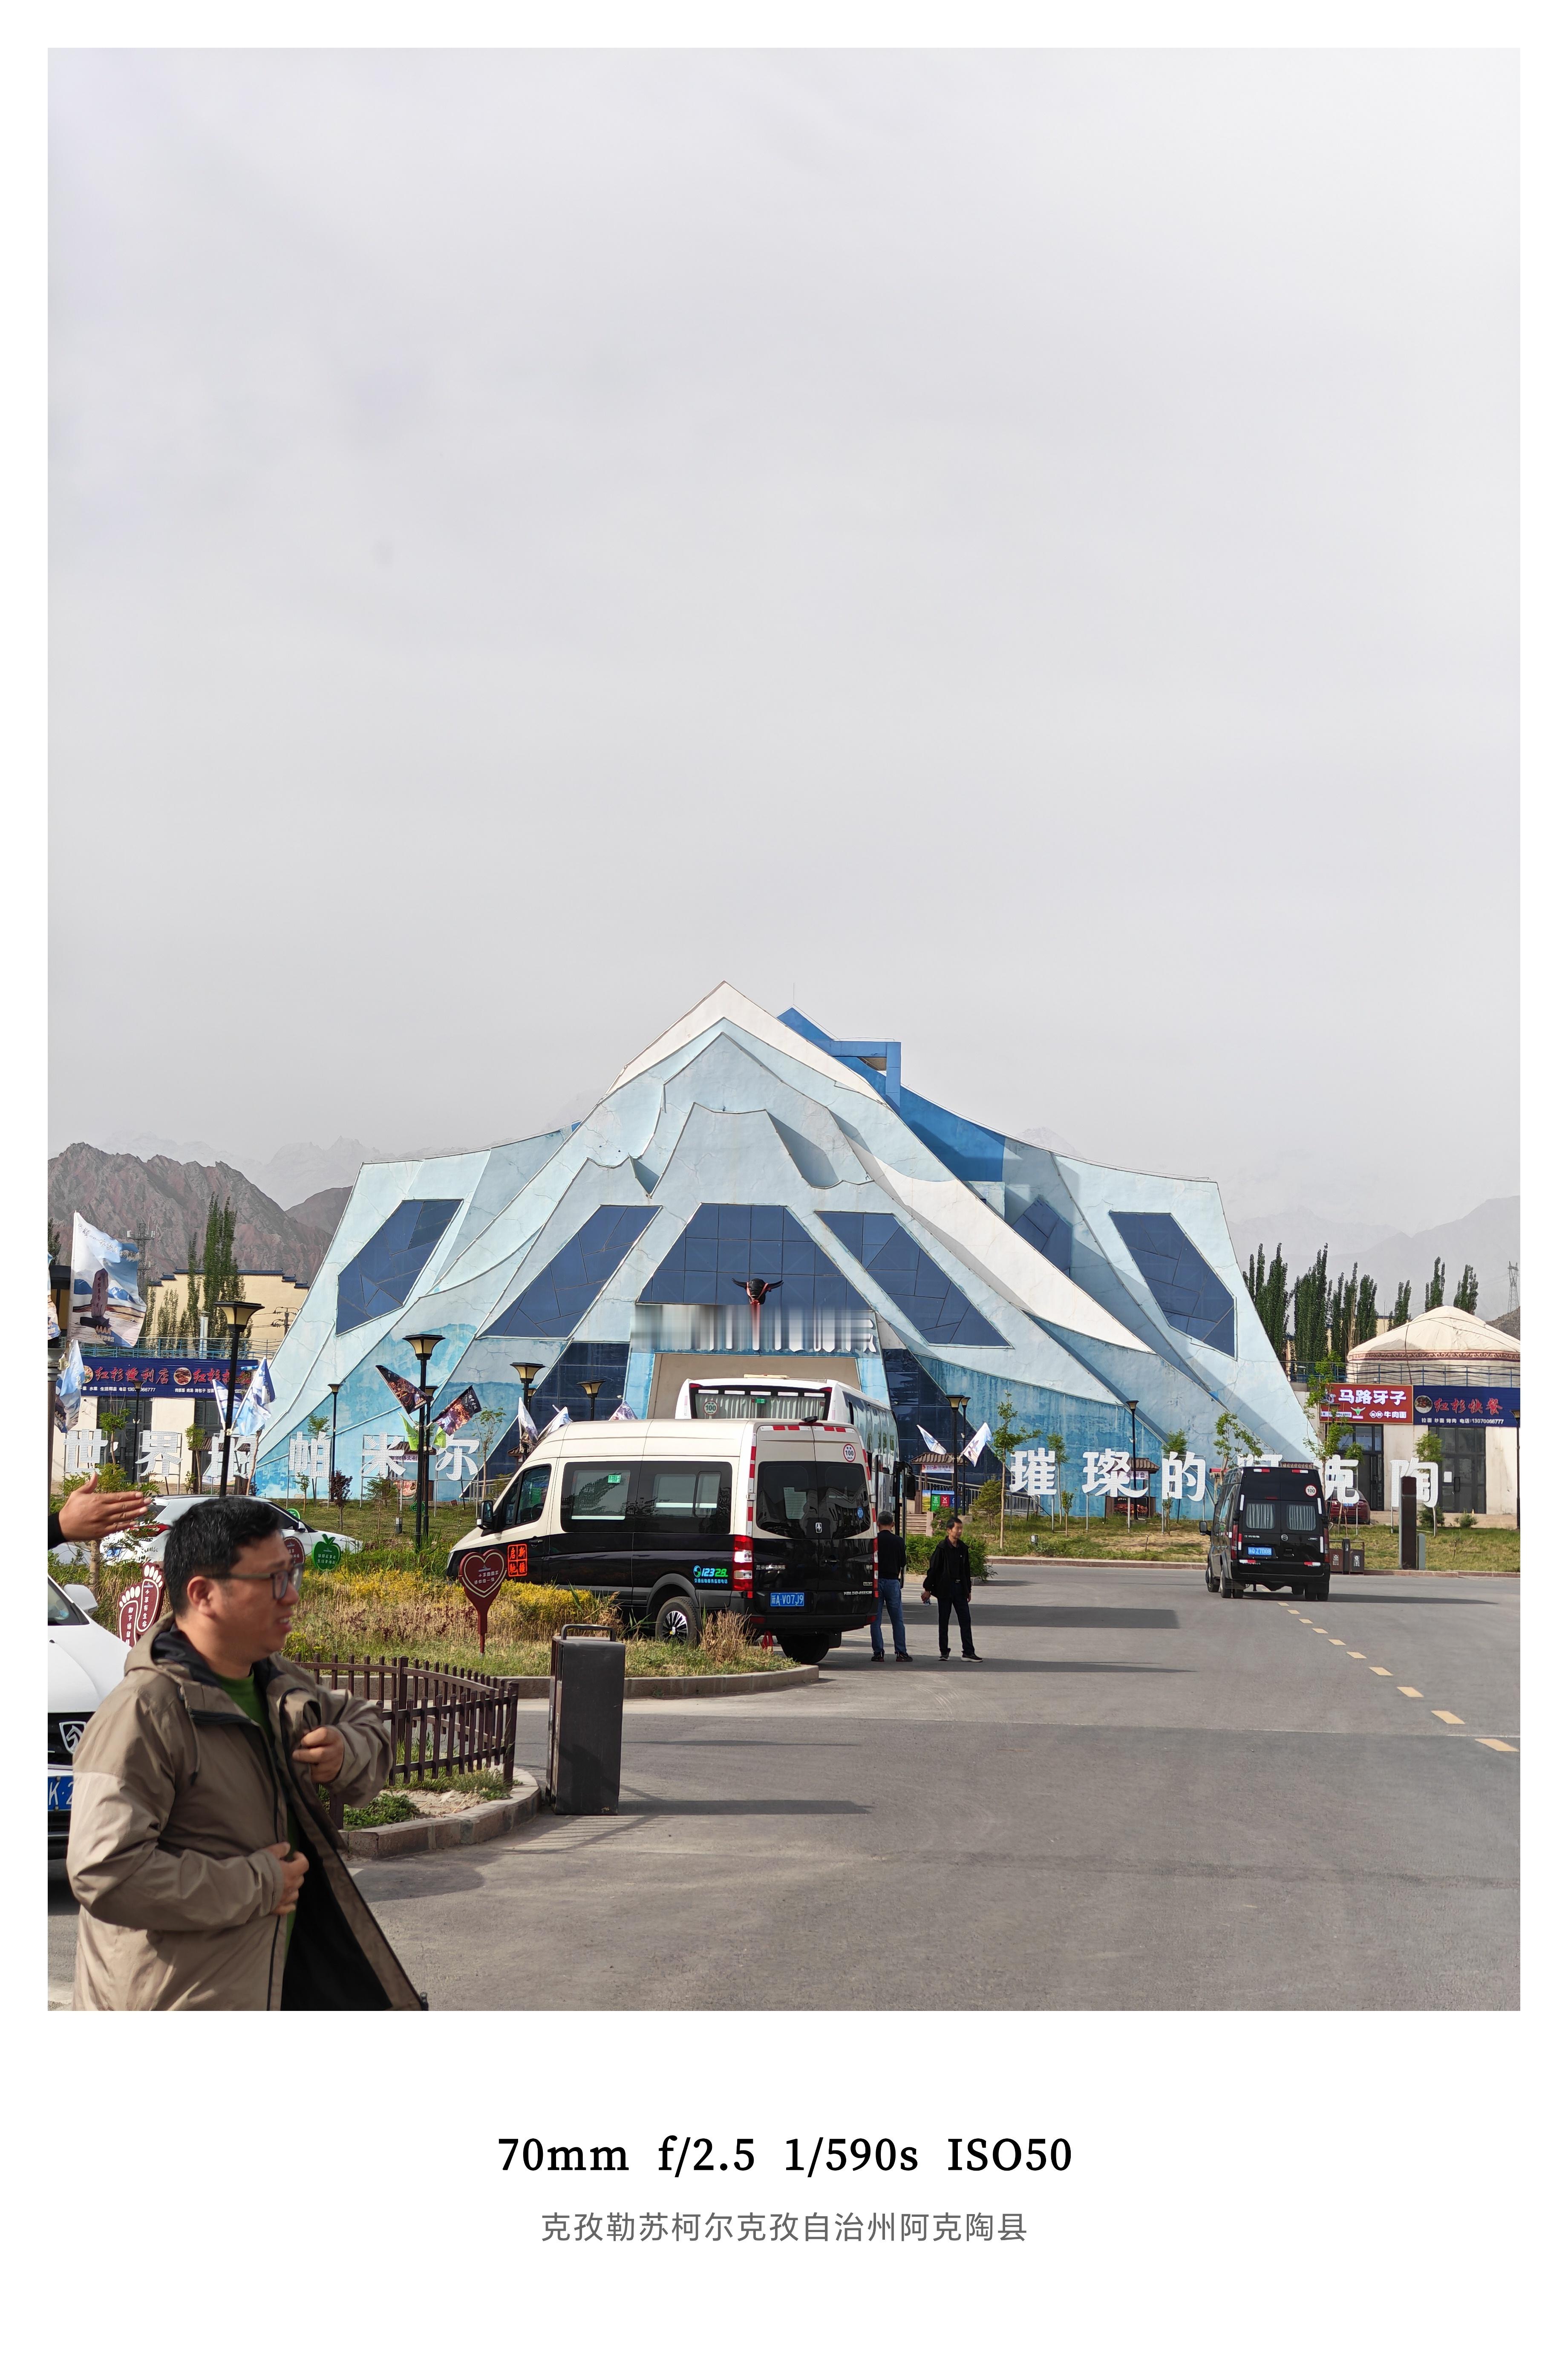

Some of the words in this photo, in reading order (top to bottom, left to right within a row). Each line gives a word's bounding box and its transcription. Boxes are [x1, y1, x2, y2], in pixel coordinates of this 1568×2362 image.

[1338, 1389, 1407, 1406] 马路牙子
[1433, 1397, 1503, 1415] 红杉快餐
[1009, 1447, 1438, 1508] 璀璨的克陶
